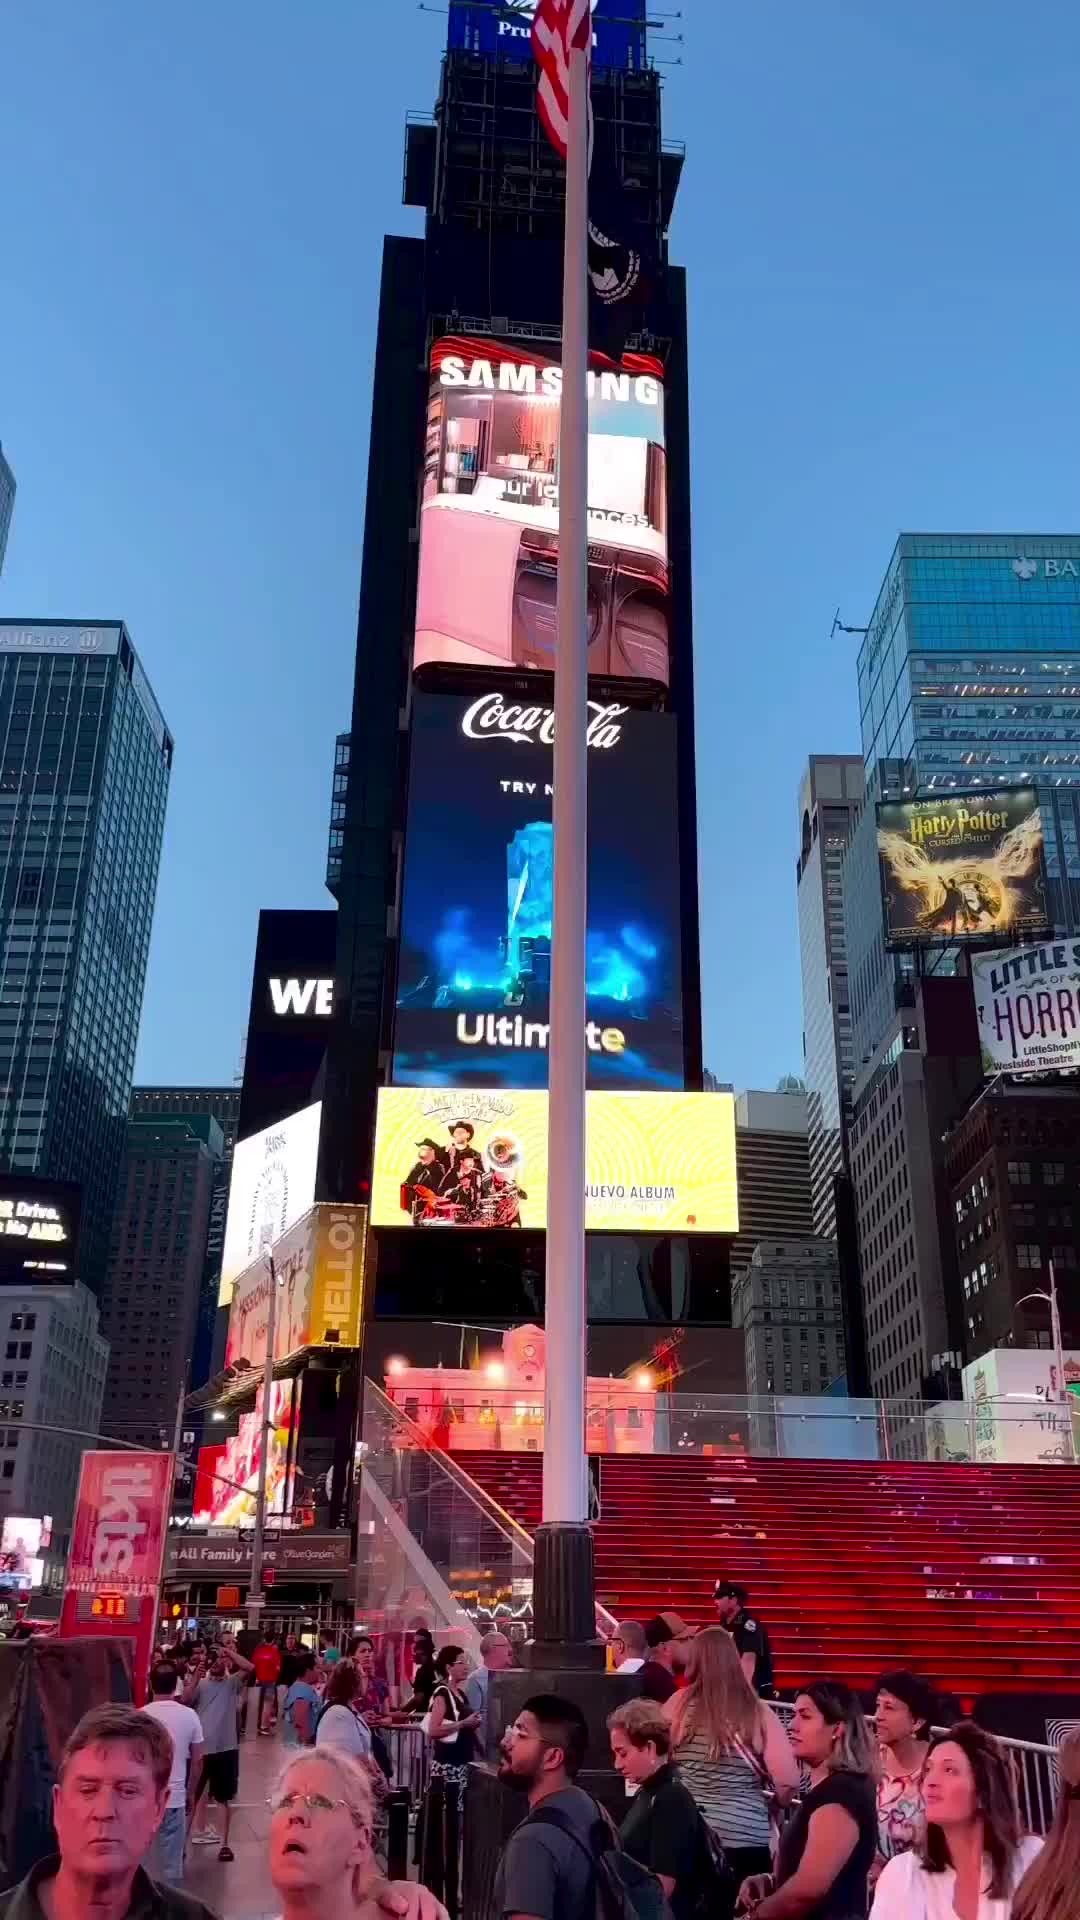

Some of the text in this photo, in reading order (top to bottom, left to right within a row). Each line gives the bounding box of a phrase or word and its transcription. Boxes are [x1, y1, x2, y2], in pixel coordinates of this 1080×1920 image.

[440, 356, 658, 404] SAMSNG
[462, 693, 629, 748] Coca-Cla
[500, 780, 537, 794] TRY
[912, 793, 1000, 810] ON BROADWAY
[911, 808, 1008, 843] Harry Potter
[990, 945, 1068, 993] LITTLE
[457, 1013, 625, 1052] Ultimte
[993, 989, 1080, 1058] HORR
[993, 1054, 1073, 1071] Westside Theatre
[630, 1186, 674, 1199] ALBUM
[322, 1213, 357, 1340] HELLO!
[200, 1547, 242, 1563] Family
[246, 1547, 277, 1560] Hre
